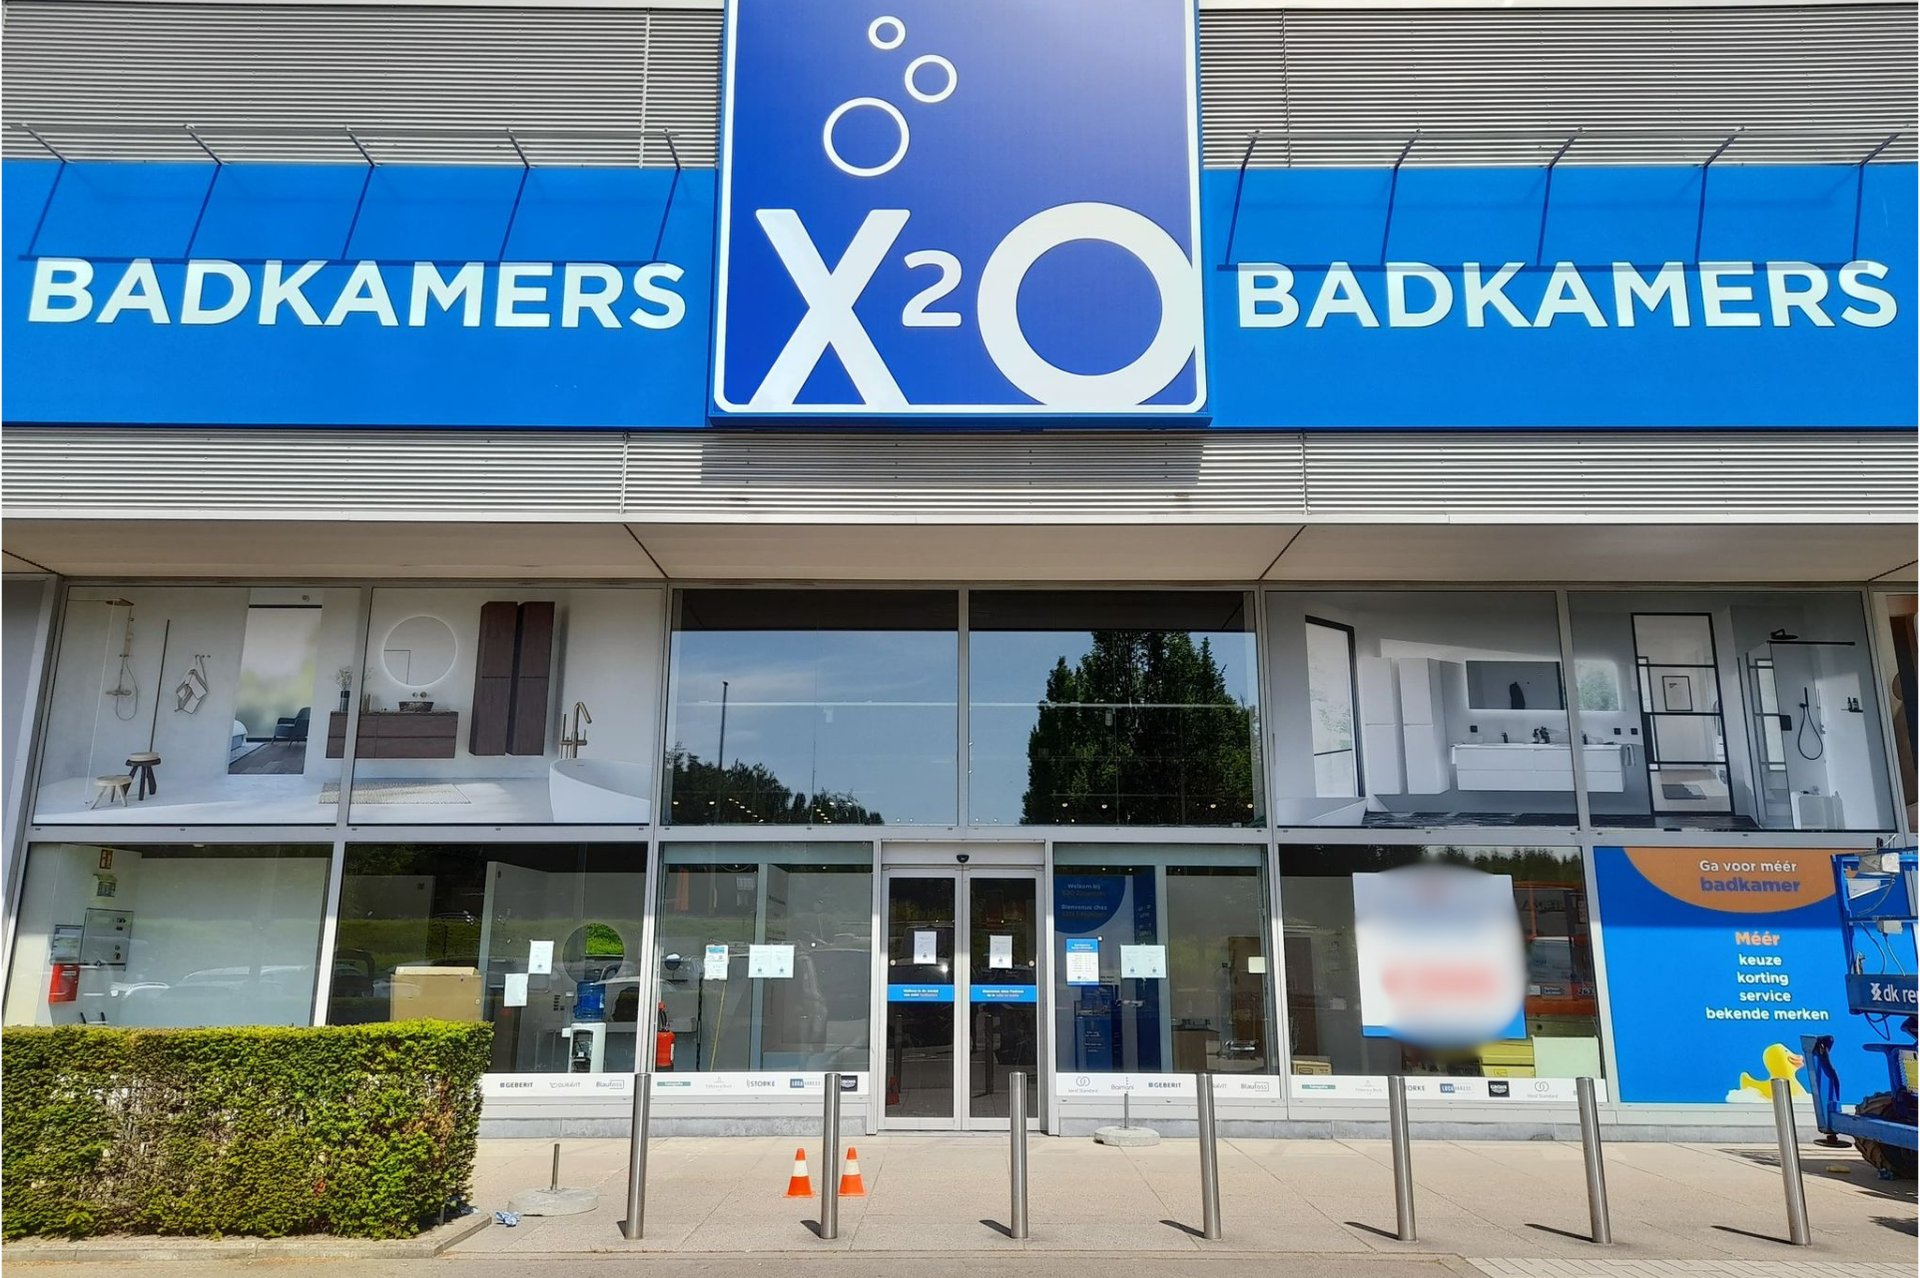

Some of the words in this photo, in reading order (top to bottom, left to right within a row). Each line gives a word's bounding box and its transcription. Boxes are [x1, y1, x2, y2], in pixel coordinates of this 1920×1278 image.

[27, 257, 687, 330] BADKAMERS
[1237, 261, 1899, 329] BADKAMERS
[1699, 860, 1719, 872] Ga
[1723, 862, 1756, 872] voor
[1760, 860, 1797, 872] méér
[1701, 877, 1800, 892] badkamer
[1735, 931, 1780, 945] Méér
[1739, 954, 1782, 966] keuze
[1737, 971, 1789, 986] korting
[1739, 989, 1791, 1001] service
[1883, 984, 1900, 1002] dk
[1902, 989, 1918, 1004] re
[1706, 1007, 1770, 1019] bekende
[1773, 1008, 1829, 1020] merken
[1154, 1081, 1181, 1089] GEBERIT
